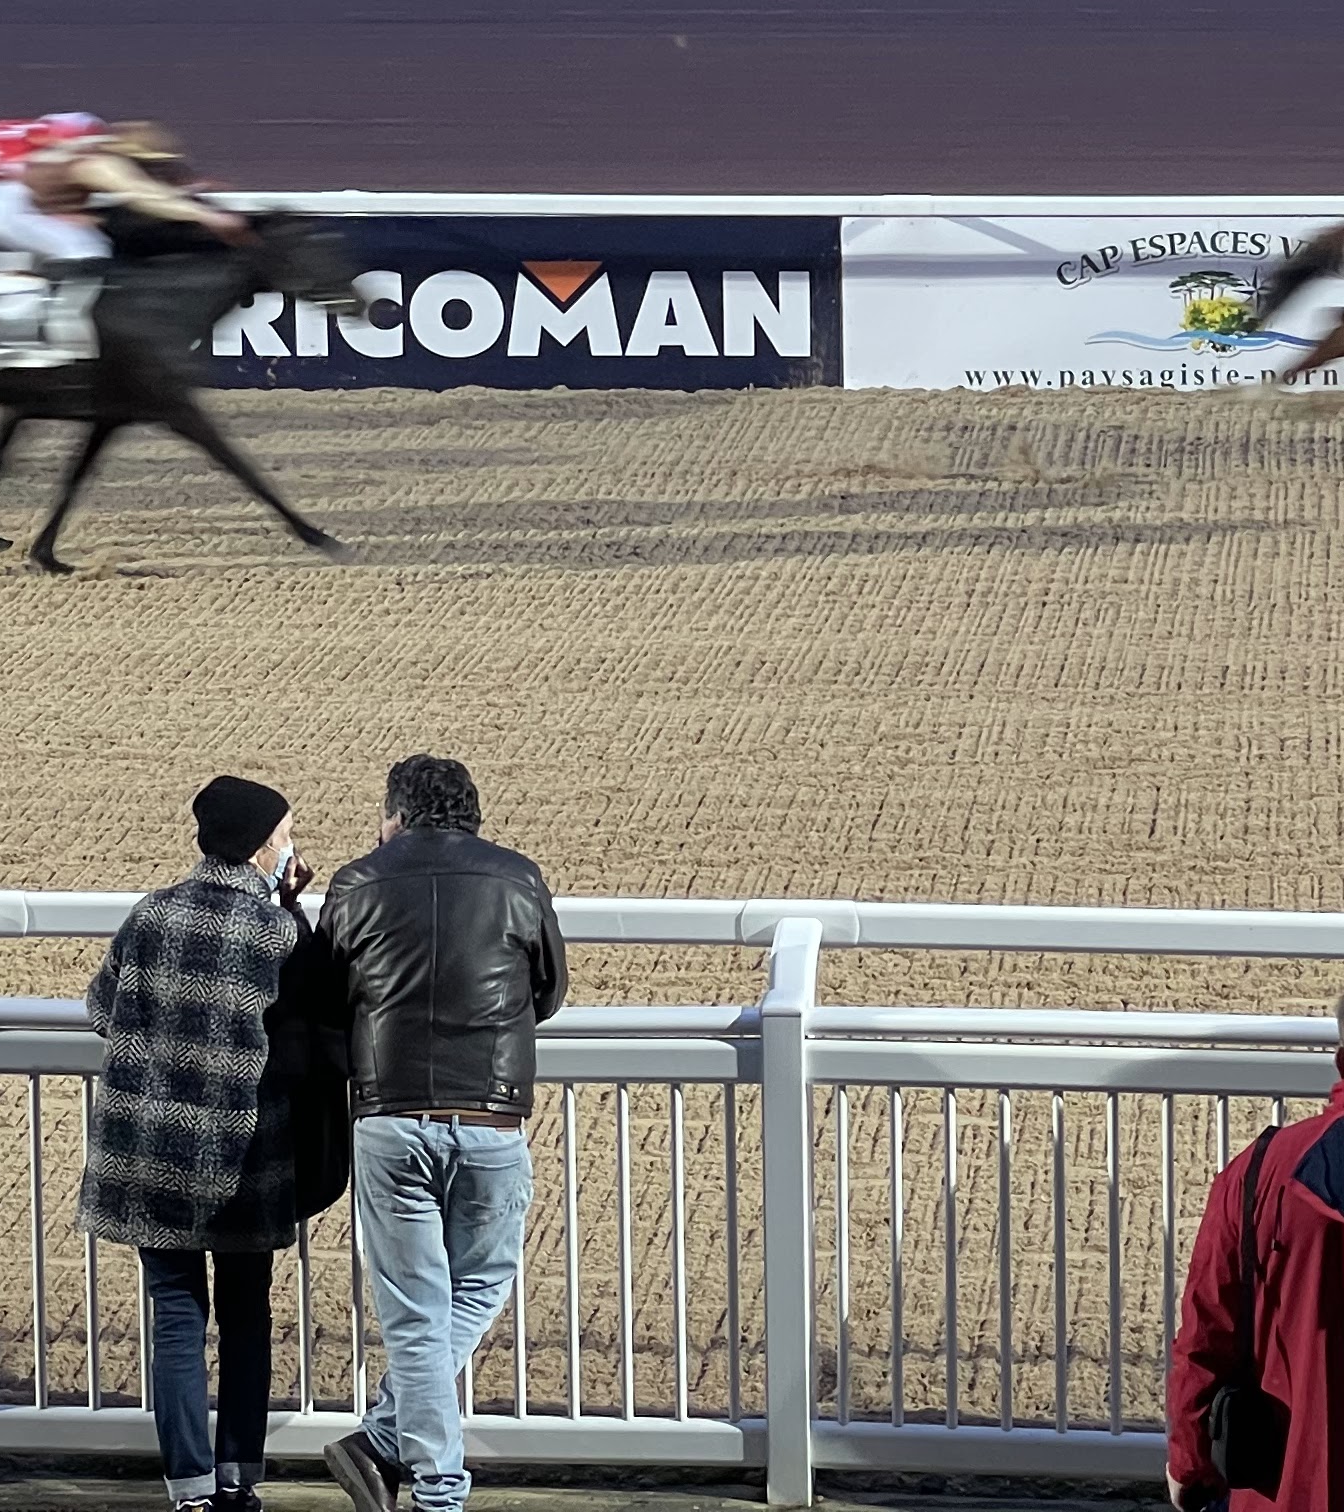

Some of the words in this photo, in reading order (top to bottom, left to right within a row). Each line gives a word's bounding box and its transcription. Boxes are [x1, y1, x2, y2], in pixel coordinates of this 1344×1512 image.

[1056, 244, 1120, 287] CAP
[1130, 230, 1269, 263] ESPACES
[206, 269, 812, 359] RICOMAN
